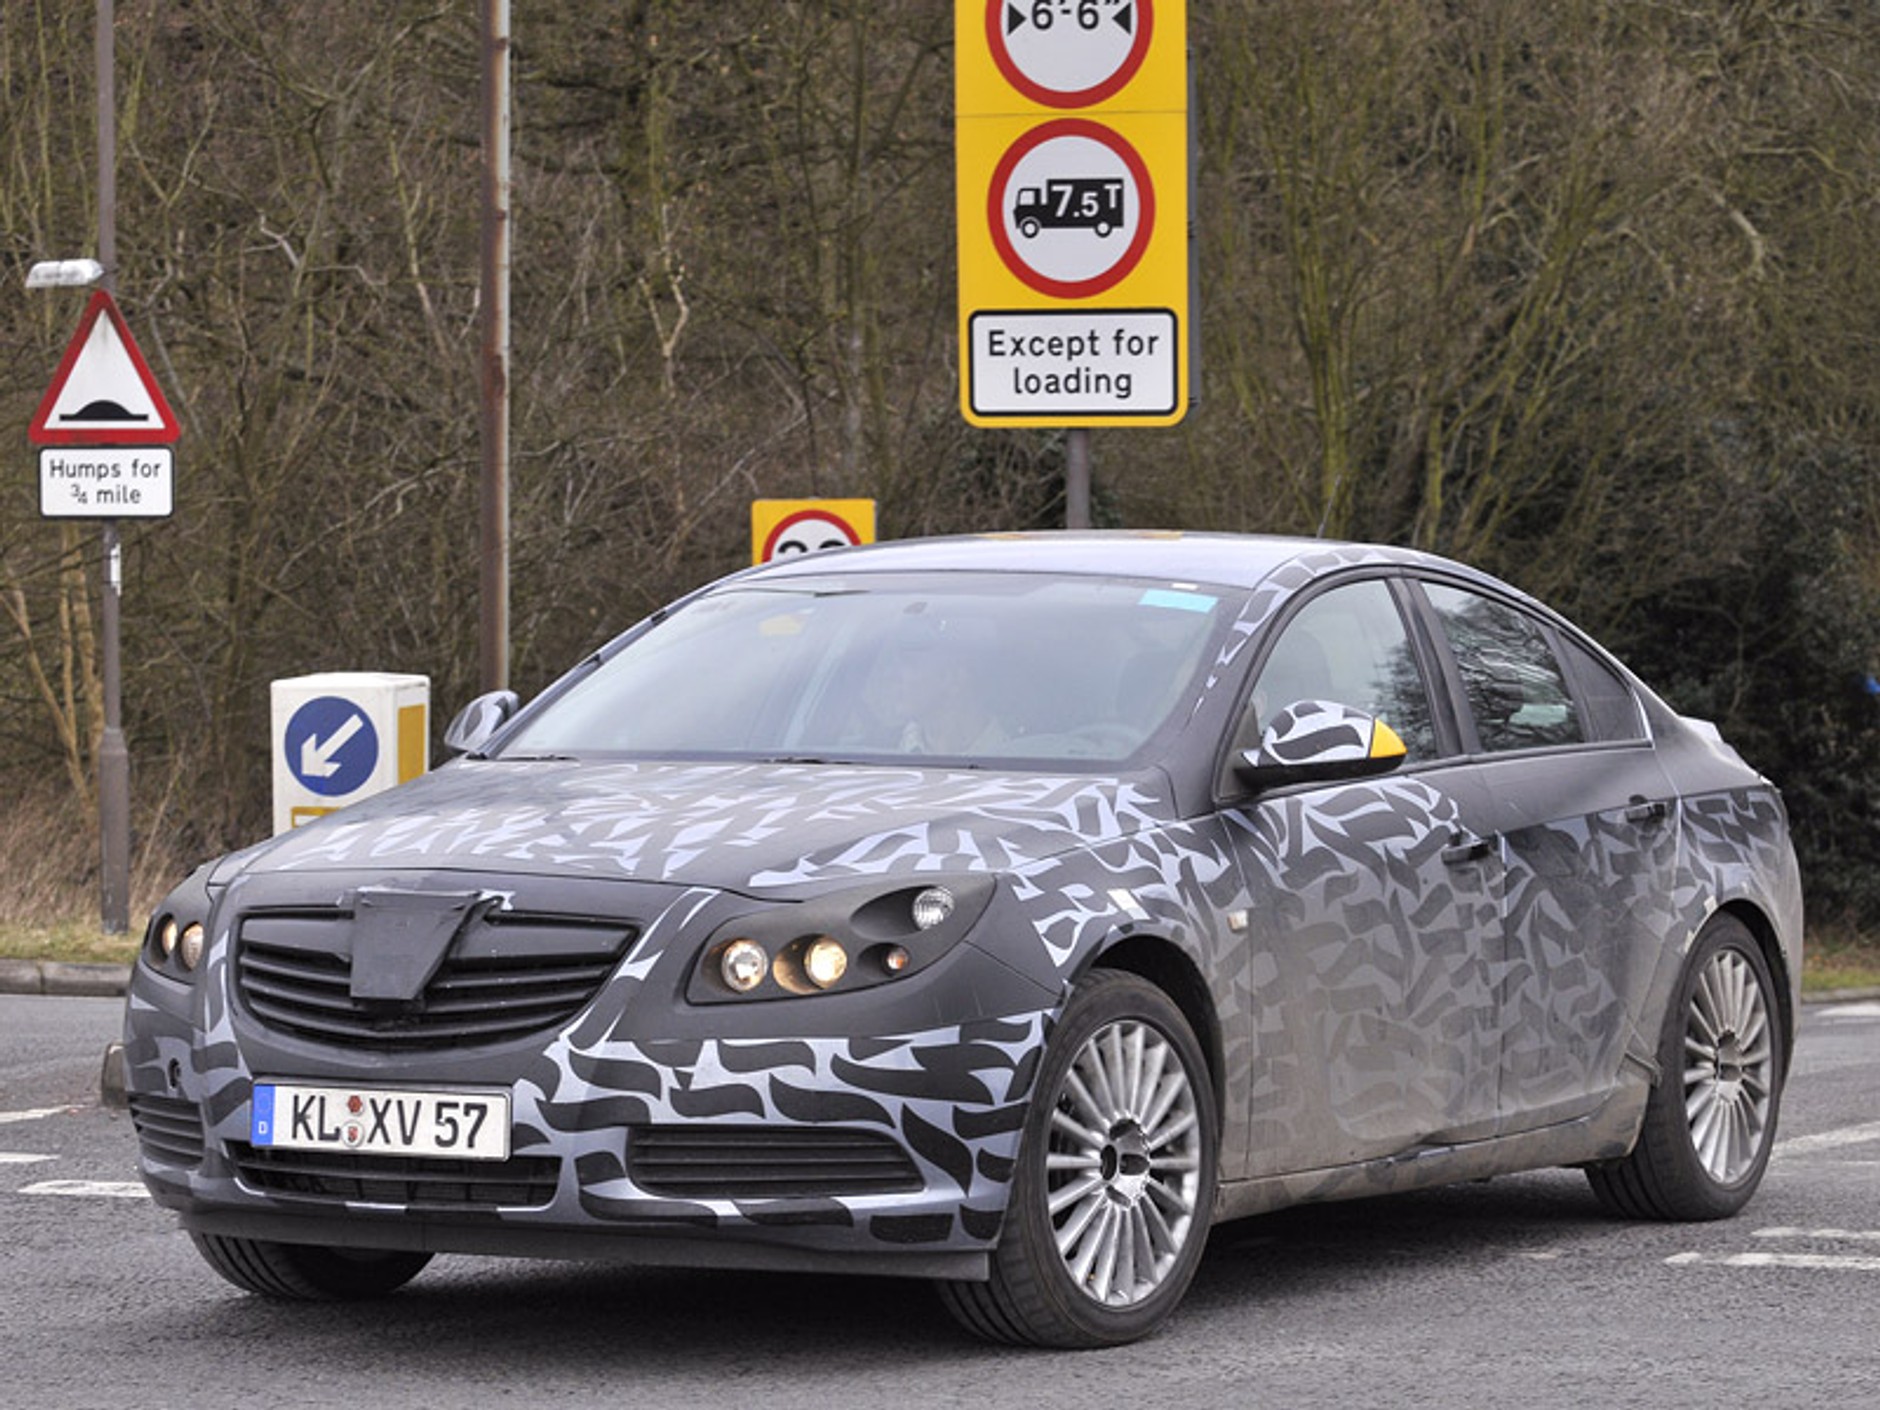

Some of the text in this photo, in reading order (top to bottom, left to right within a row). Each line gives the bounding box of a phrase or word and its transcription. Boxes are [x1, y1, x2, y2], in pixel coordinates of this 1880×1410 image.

[988, 328, 1160, 361] Except for
[1013, 366, 1133, 400] loading
[49, 458, 161, 482] Humps for
[96, 484, 142, 504] mile
[291, 1094, 488, 1149] KL XV 57
